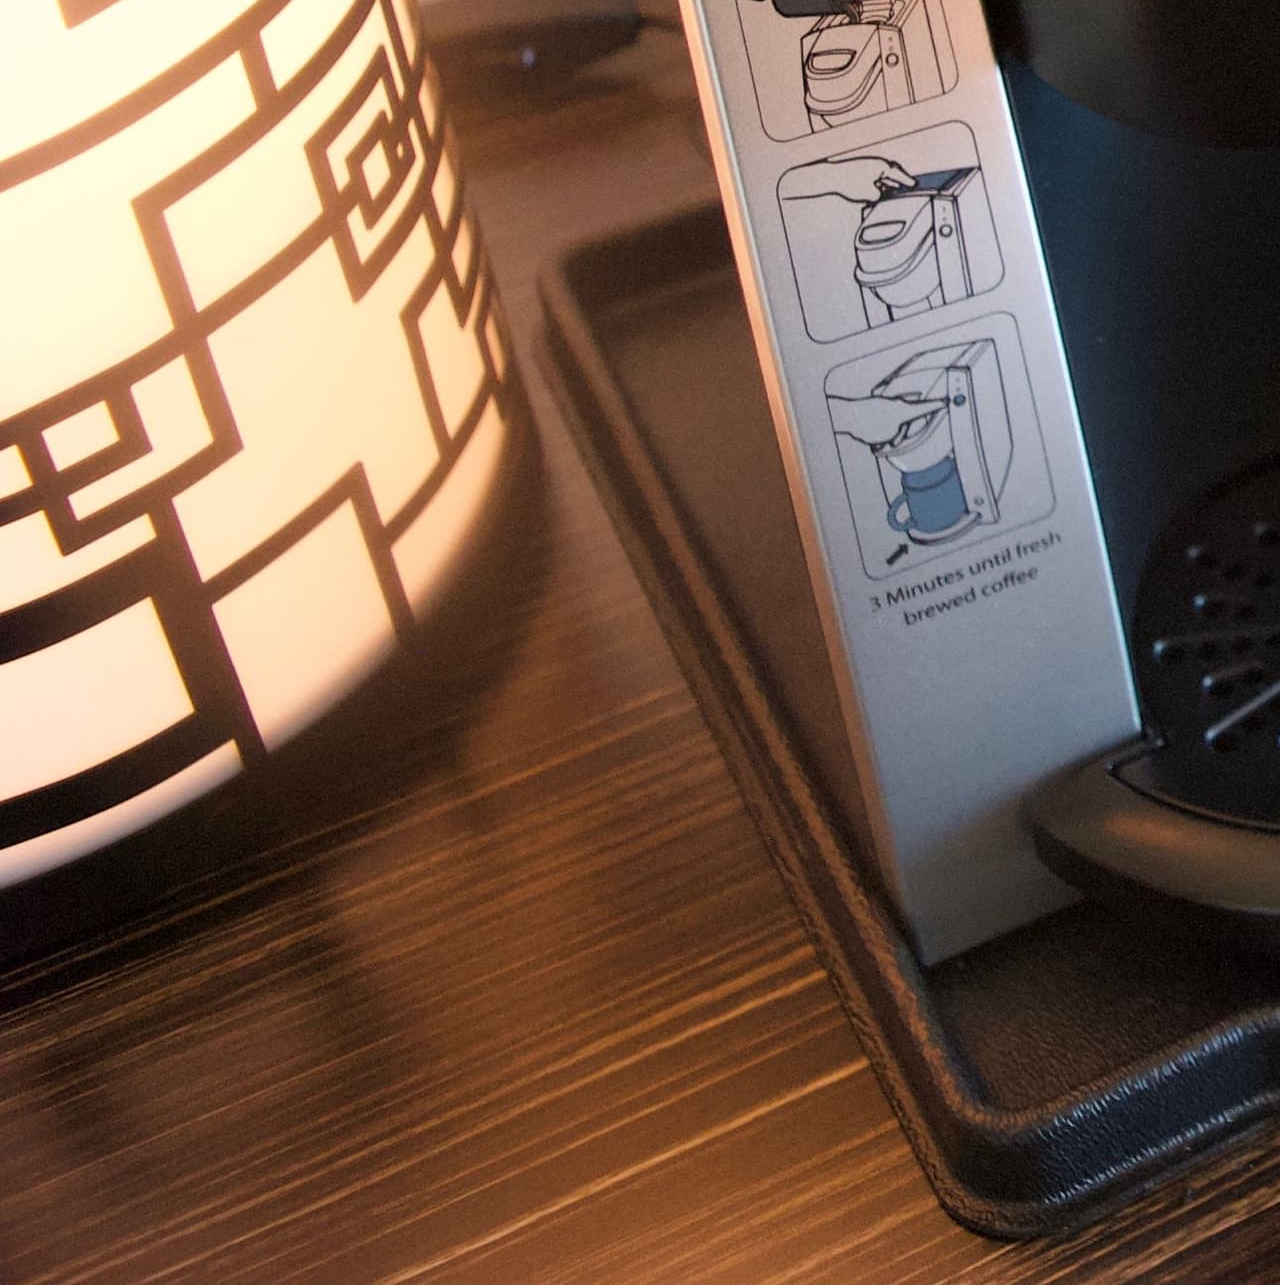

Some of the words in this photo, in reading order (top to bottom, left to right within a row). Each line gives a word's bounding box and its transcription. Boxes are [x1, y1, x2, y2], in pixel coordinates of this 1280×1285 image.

[869, 595, 883, 613] 3
[886, 567, 965, 606] Minutes
[968, 547, 1012, 577] until
[1015, 530, 1063, 561] fresh
[903, 585, 977, 627] brewed
[981, 565, 1039, 598] coffee
